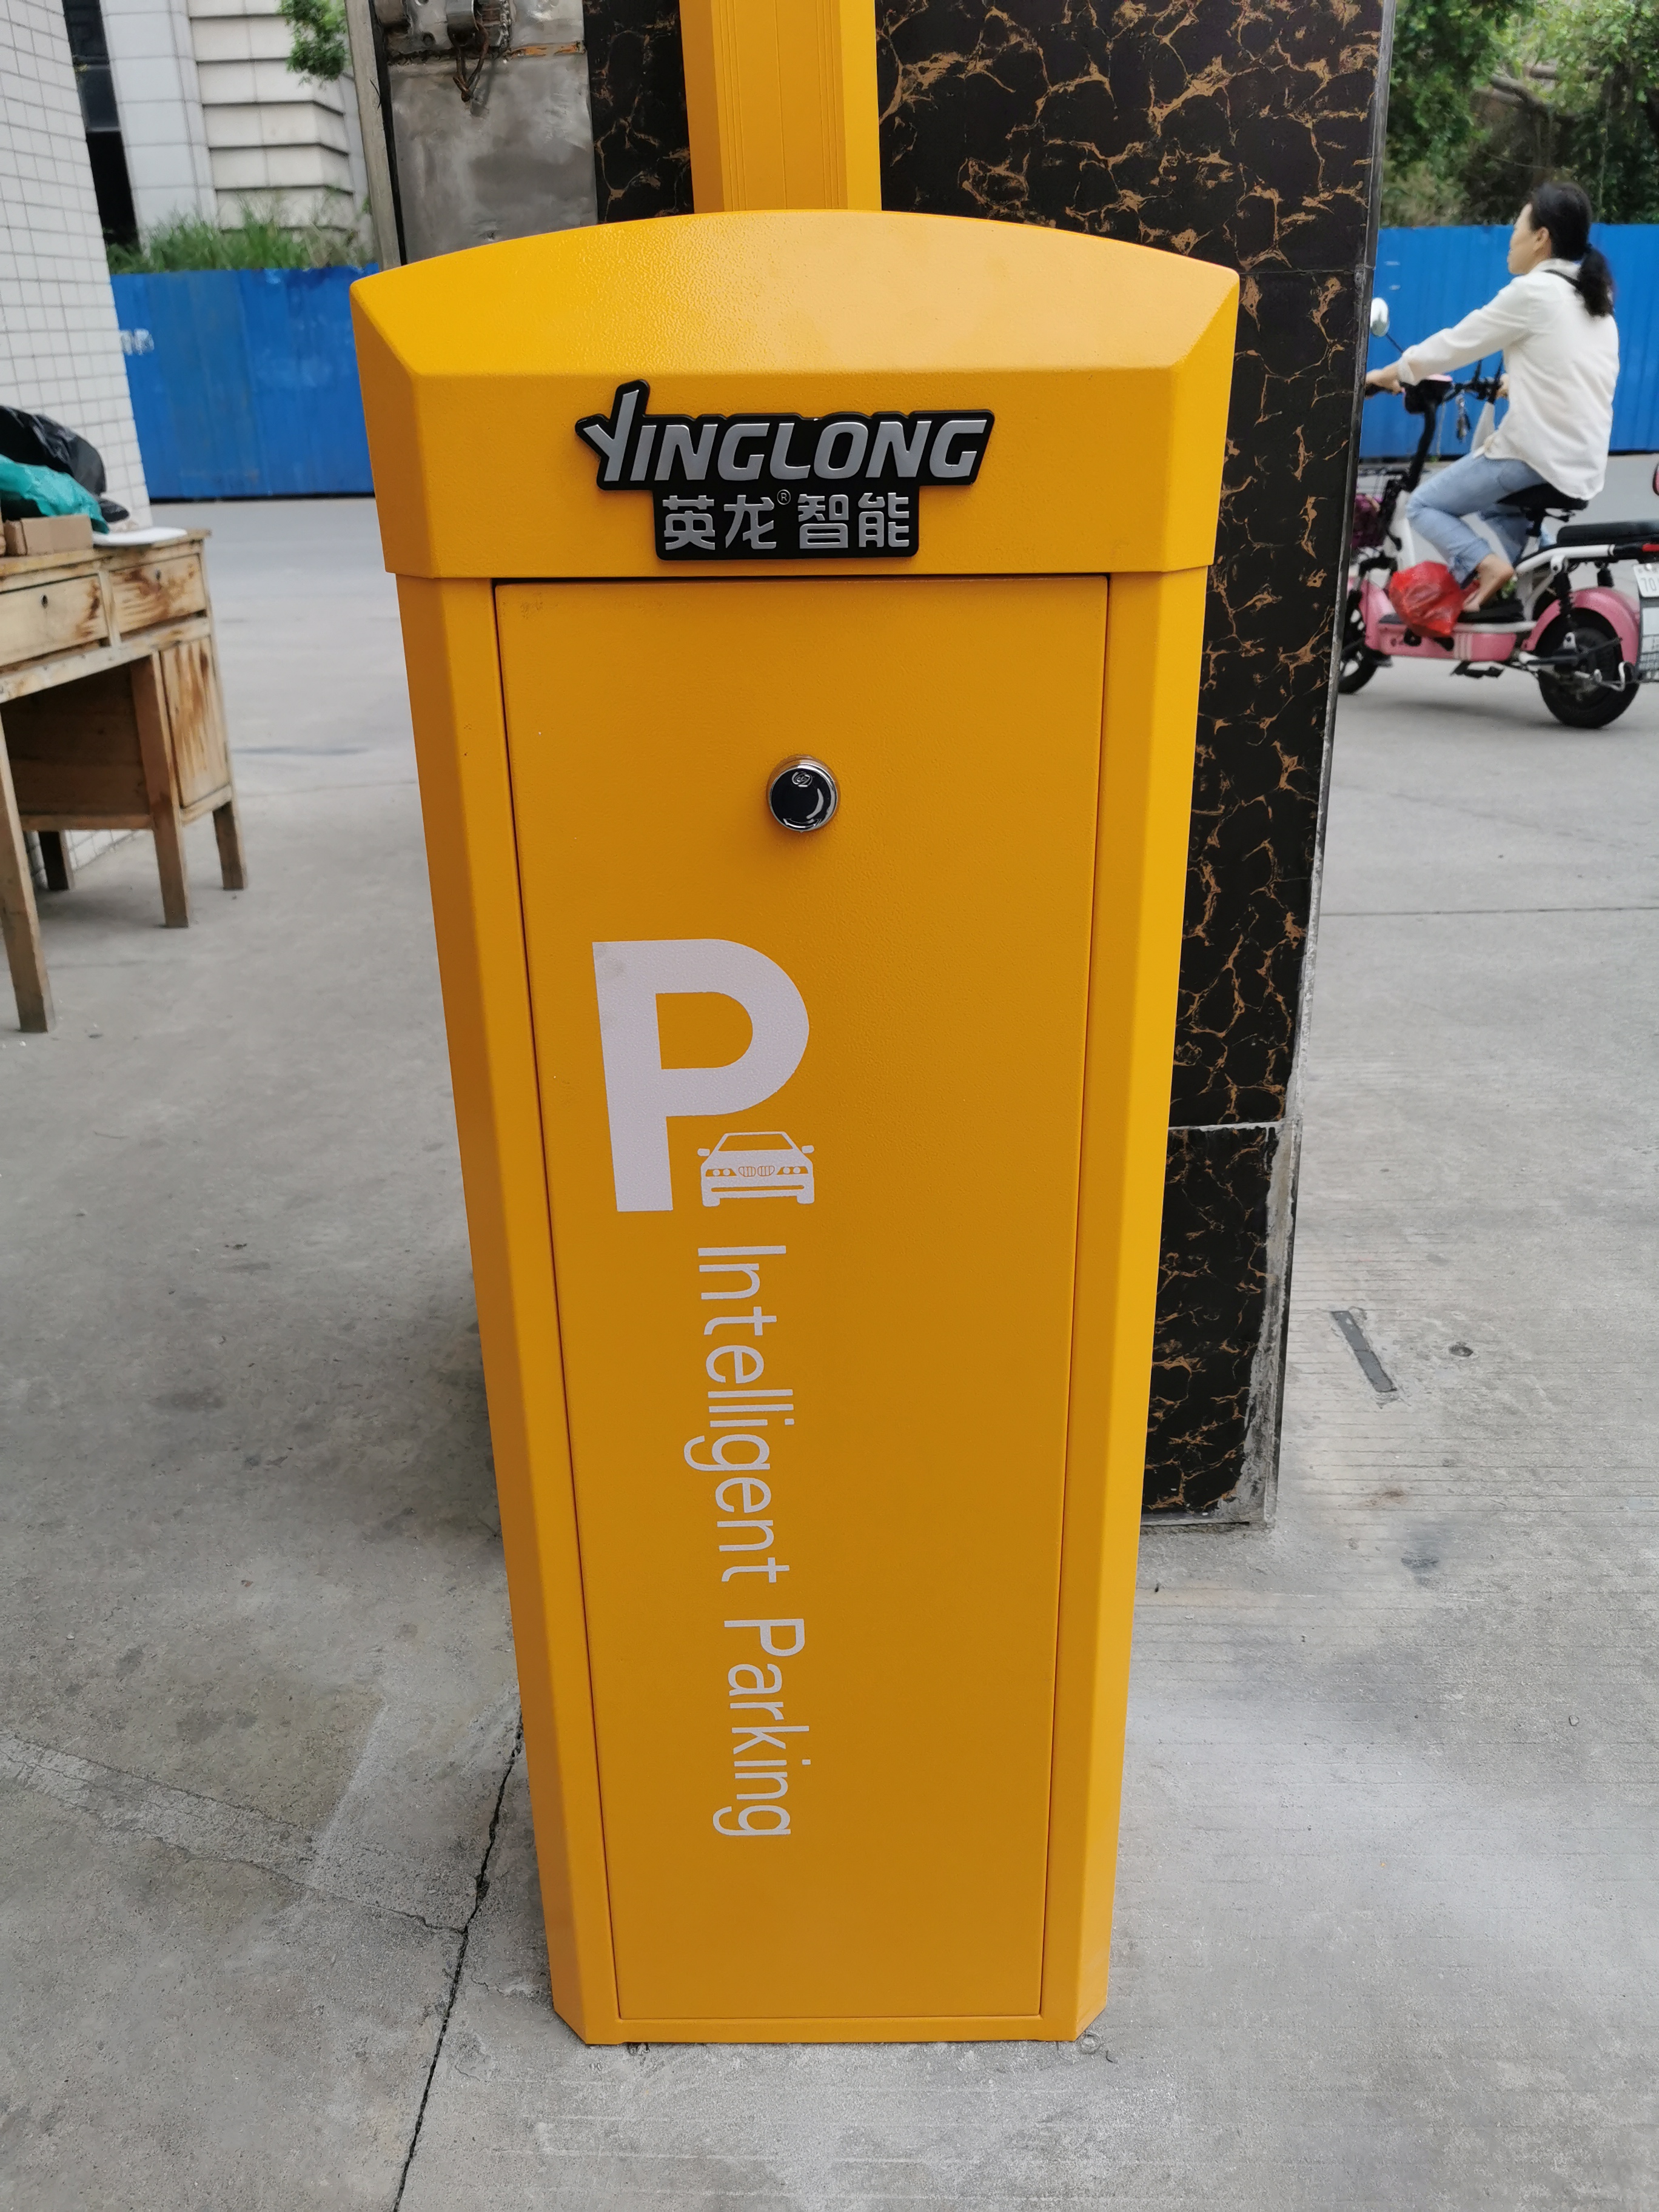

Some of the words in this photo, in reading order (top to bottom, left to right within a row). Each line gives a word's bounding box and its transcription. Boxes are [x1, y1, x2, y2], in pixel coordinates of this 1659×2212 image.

[581, 389, 988, 482] YINGLONG
[1640, 577, 1659, 592] 70
[592, 938, 810, 1212] P
[683, 1245, 795, 1584] Intelligent
[712, 1618, 811, 1836] Parking
